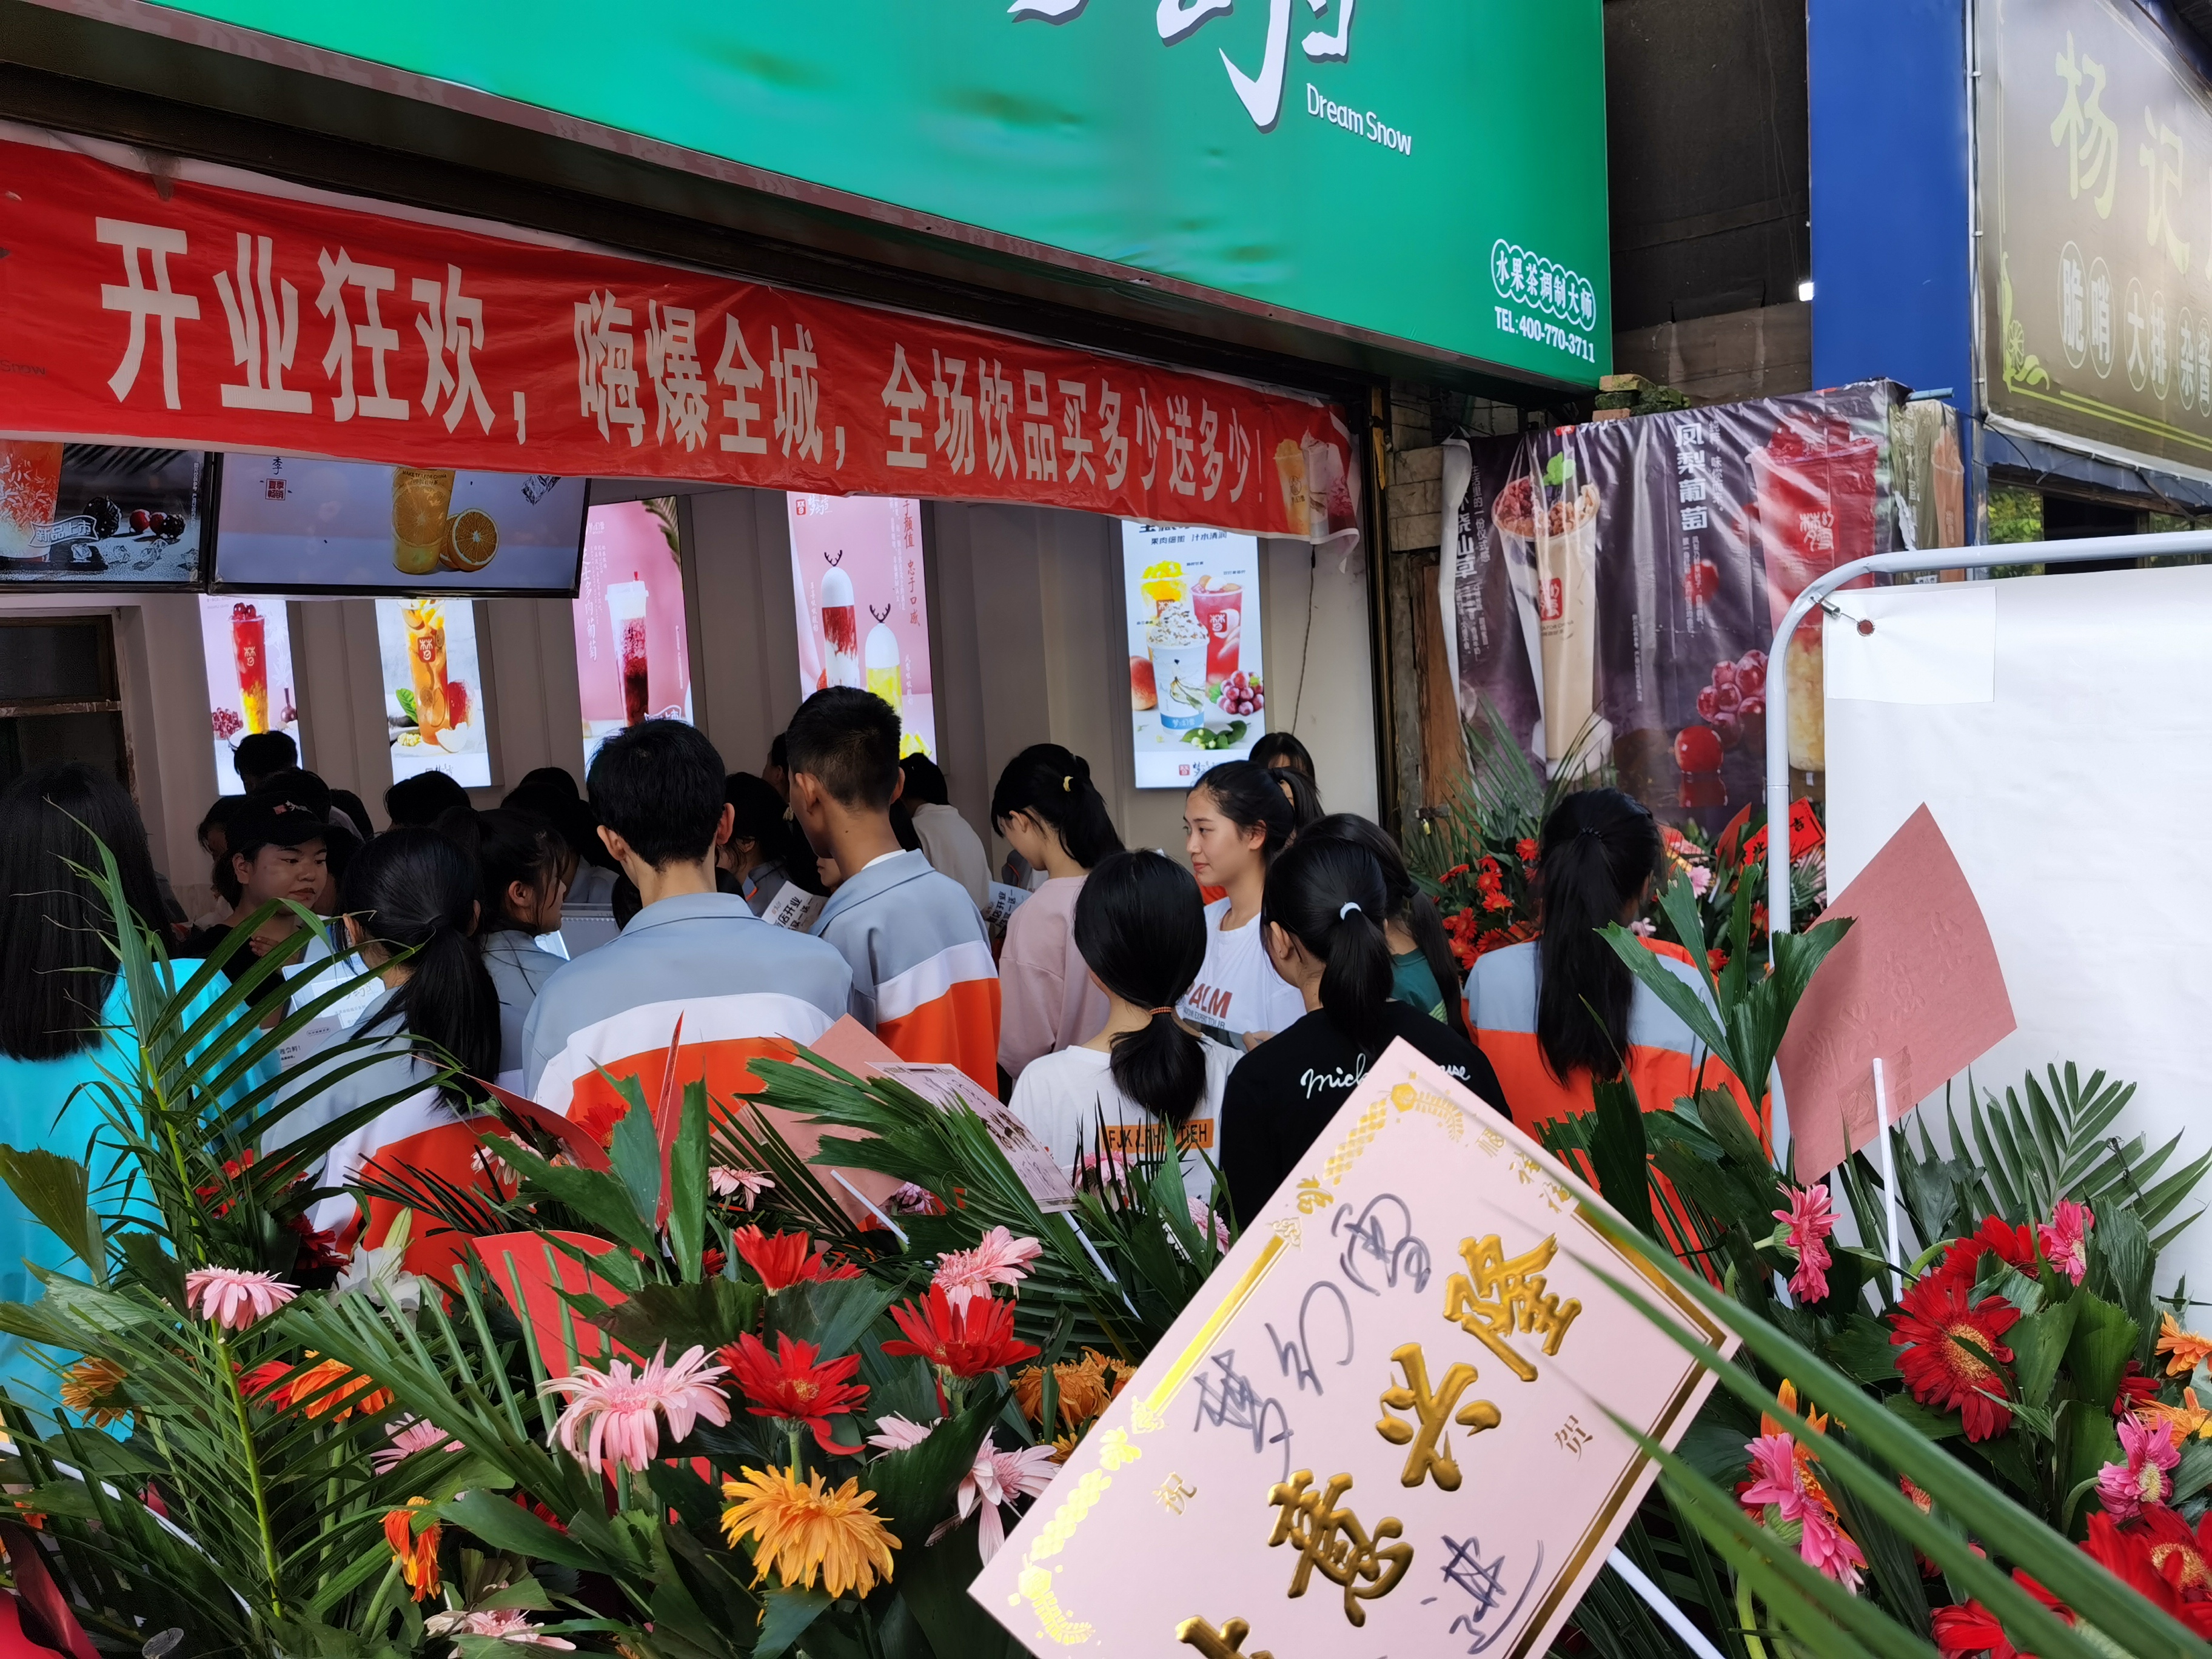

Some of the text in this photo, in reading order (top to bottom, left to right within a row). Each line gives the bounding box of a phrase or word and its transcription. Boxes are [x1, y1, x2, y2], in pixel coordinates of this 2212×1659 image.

[1306, 82, 1412, 156] Dream Snow
[2050, 30, 2212, 281] 杨记
[1495, 249, 1592, 321] 水果茶调制大师
[1494, 306, 1595, 364] TEL:400-770-3711
[2062, 258, 2111, 364] 脆哨
[2127, 292, 2167, 386] 大排
[1675, 422, 1708, 531] 凤梨葡萄
[35, 520, 92, 542] 新品上市
[1208, 1016, 1225, 1030] TOUR
[1552, 1413, 1595, 1461] 贺
[1152, 1470, 1199, 1518] 祝
